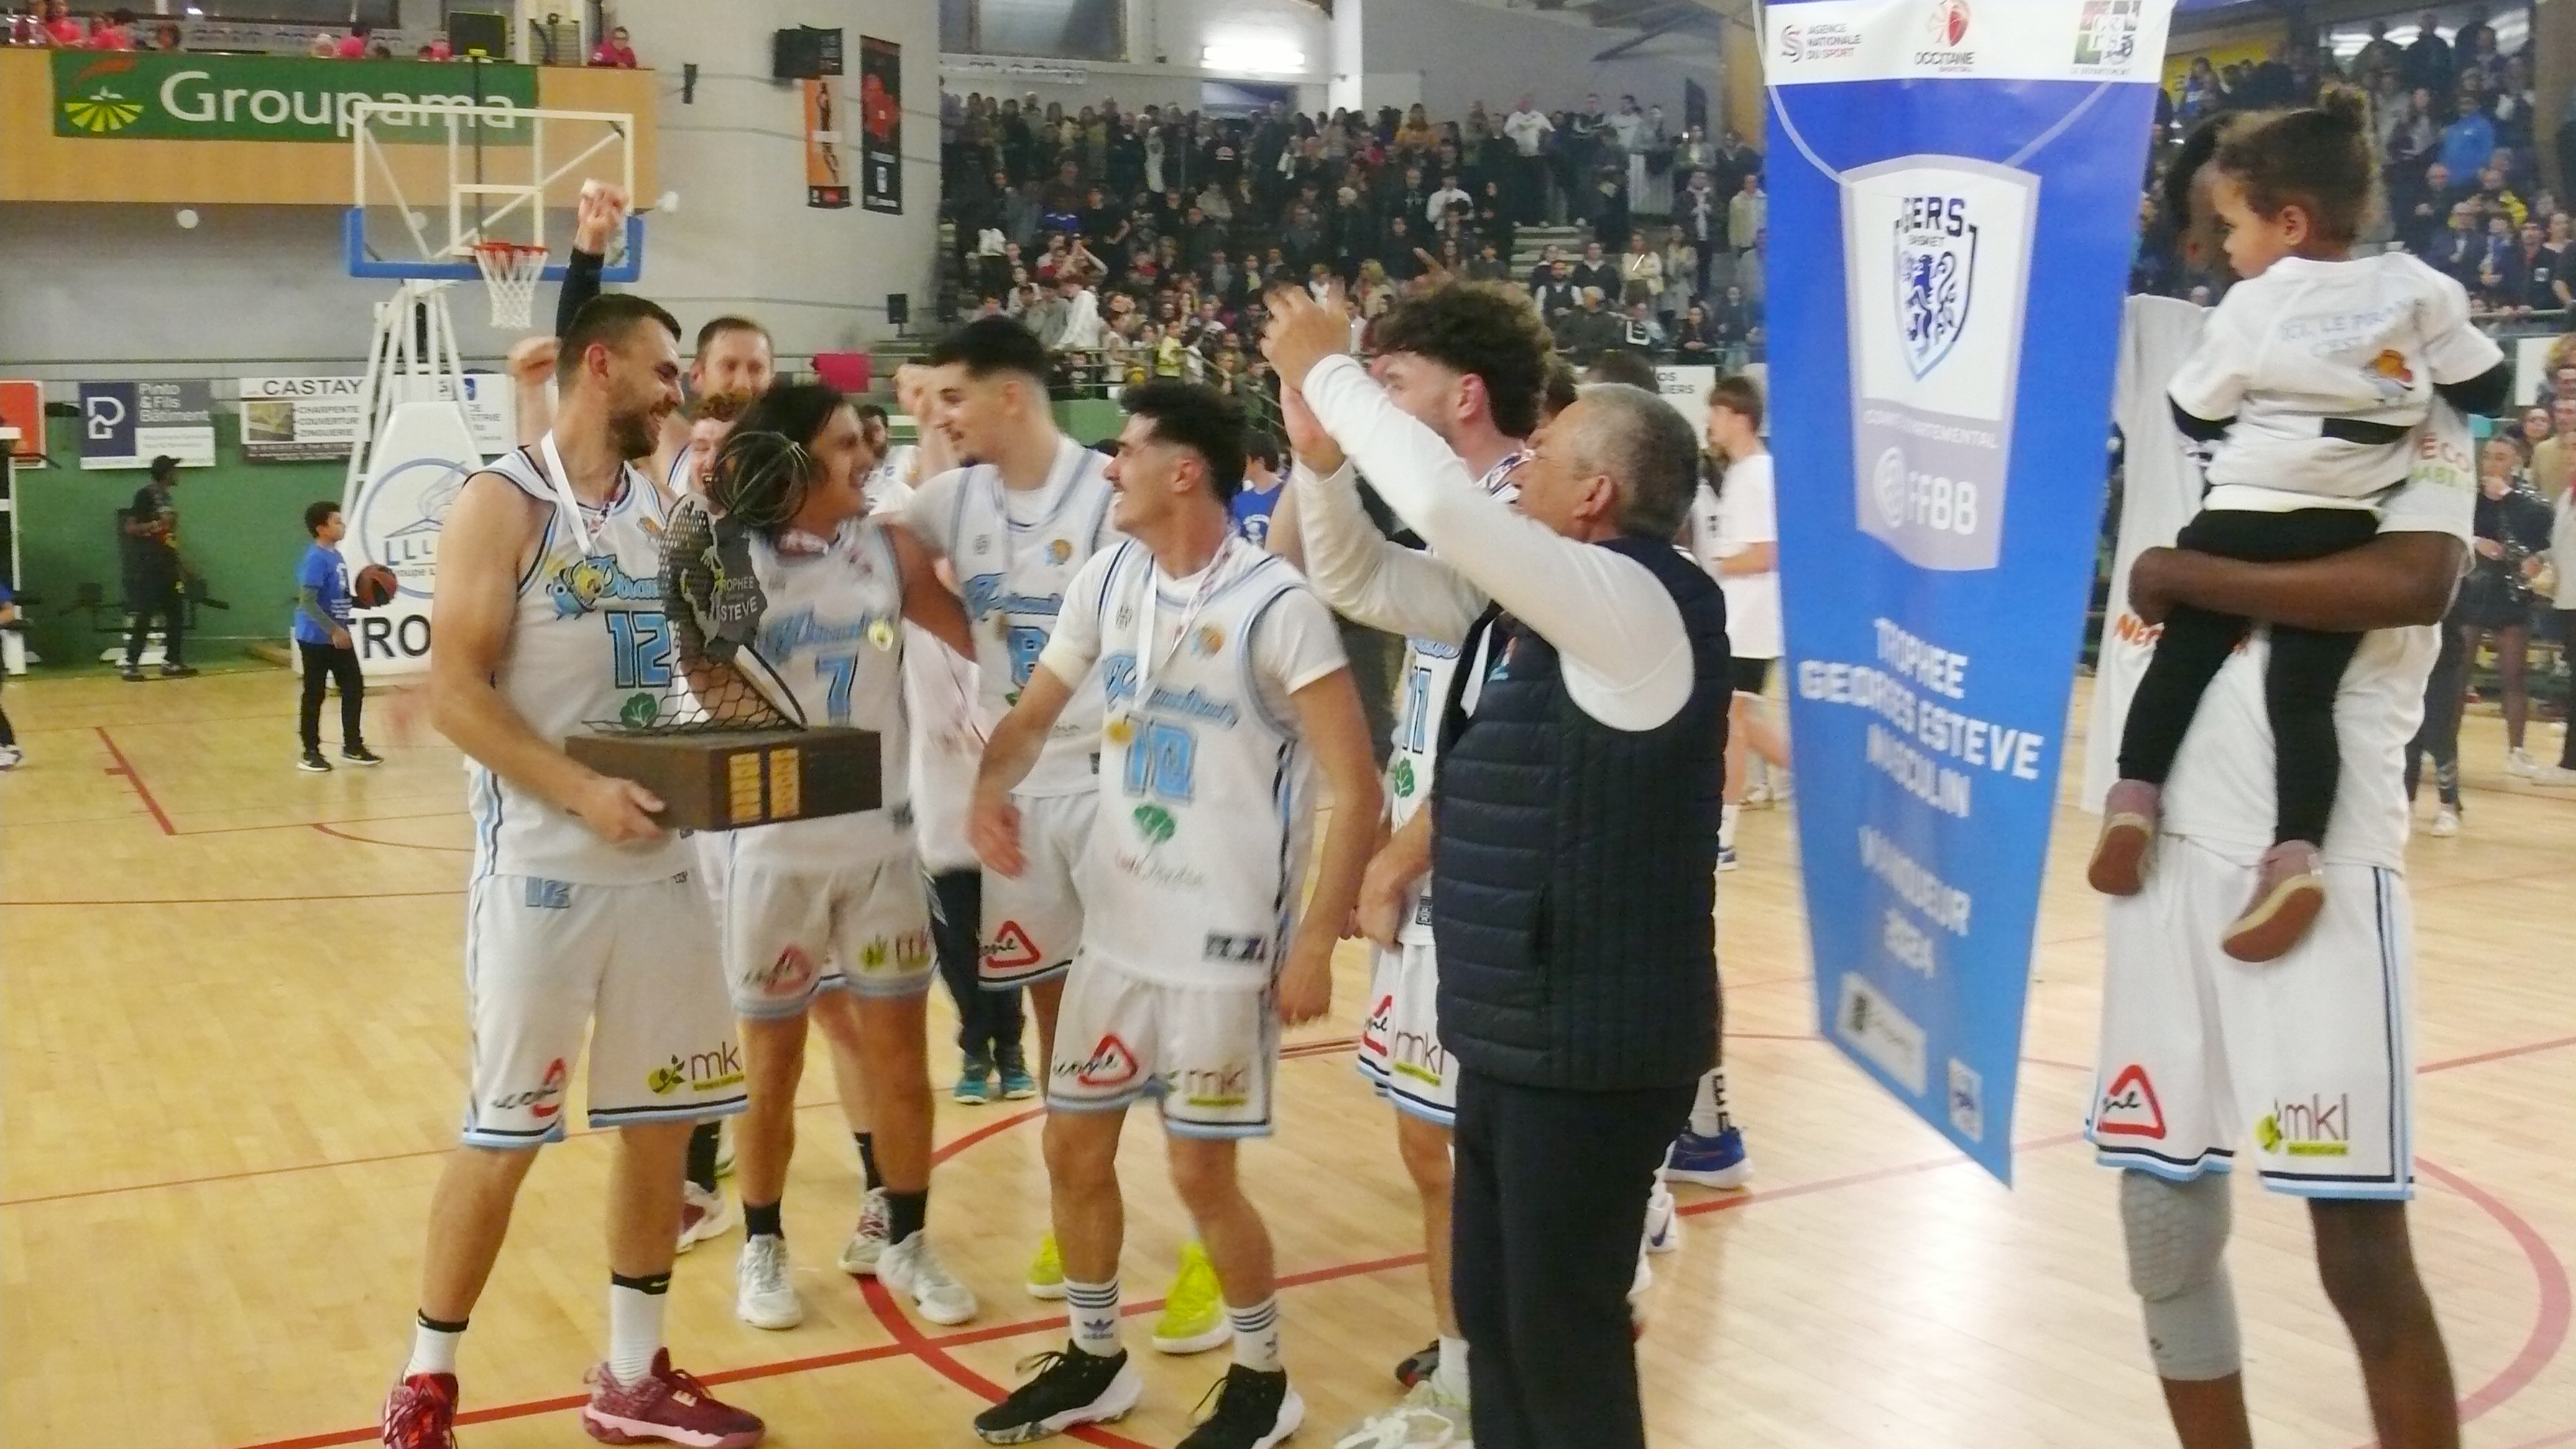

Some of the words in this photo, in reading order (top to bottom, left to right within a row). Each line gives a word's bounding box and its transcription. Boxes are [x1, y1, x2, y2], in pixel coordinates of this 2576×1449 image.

[1807, 34, 1862, 47] NATIONALE
[1808, 24, 1847, 34] AGENCE
[160, 70, 516, 137] Groupama
[139, 383, 180, 395] Pinto
[153, 396, 181, 408] Fils
[263, 380, 364, 395] CASTAY
[300, 417, 361, 426] COUVERTUR
[1907, 471, 1977, 535] FFBB
[720, 596, 758, 622] STEVE
[604, 610, 673, 689] 12
[814, 649, 860, 722] 7
[1402, 666, 1432, 755] 11
[1123, 715, 1199, 805] 10
[1918, 700, 2045, 781] ESTEVE
[1395, 1031, 1445, 1075] mkl
[2284, 1092, 2348, 1141] mkl
